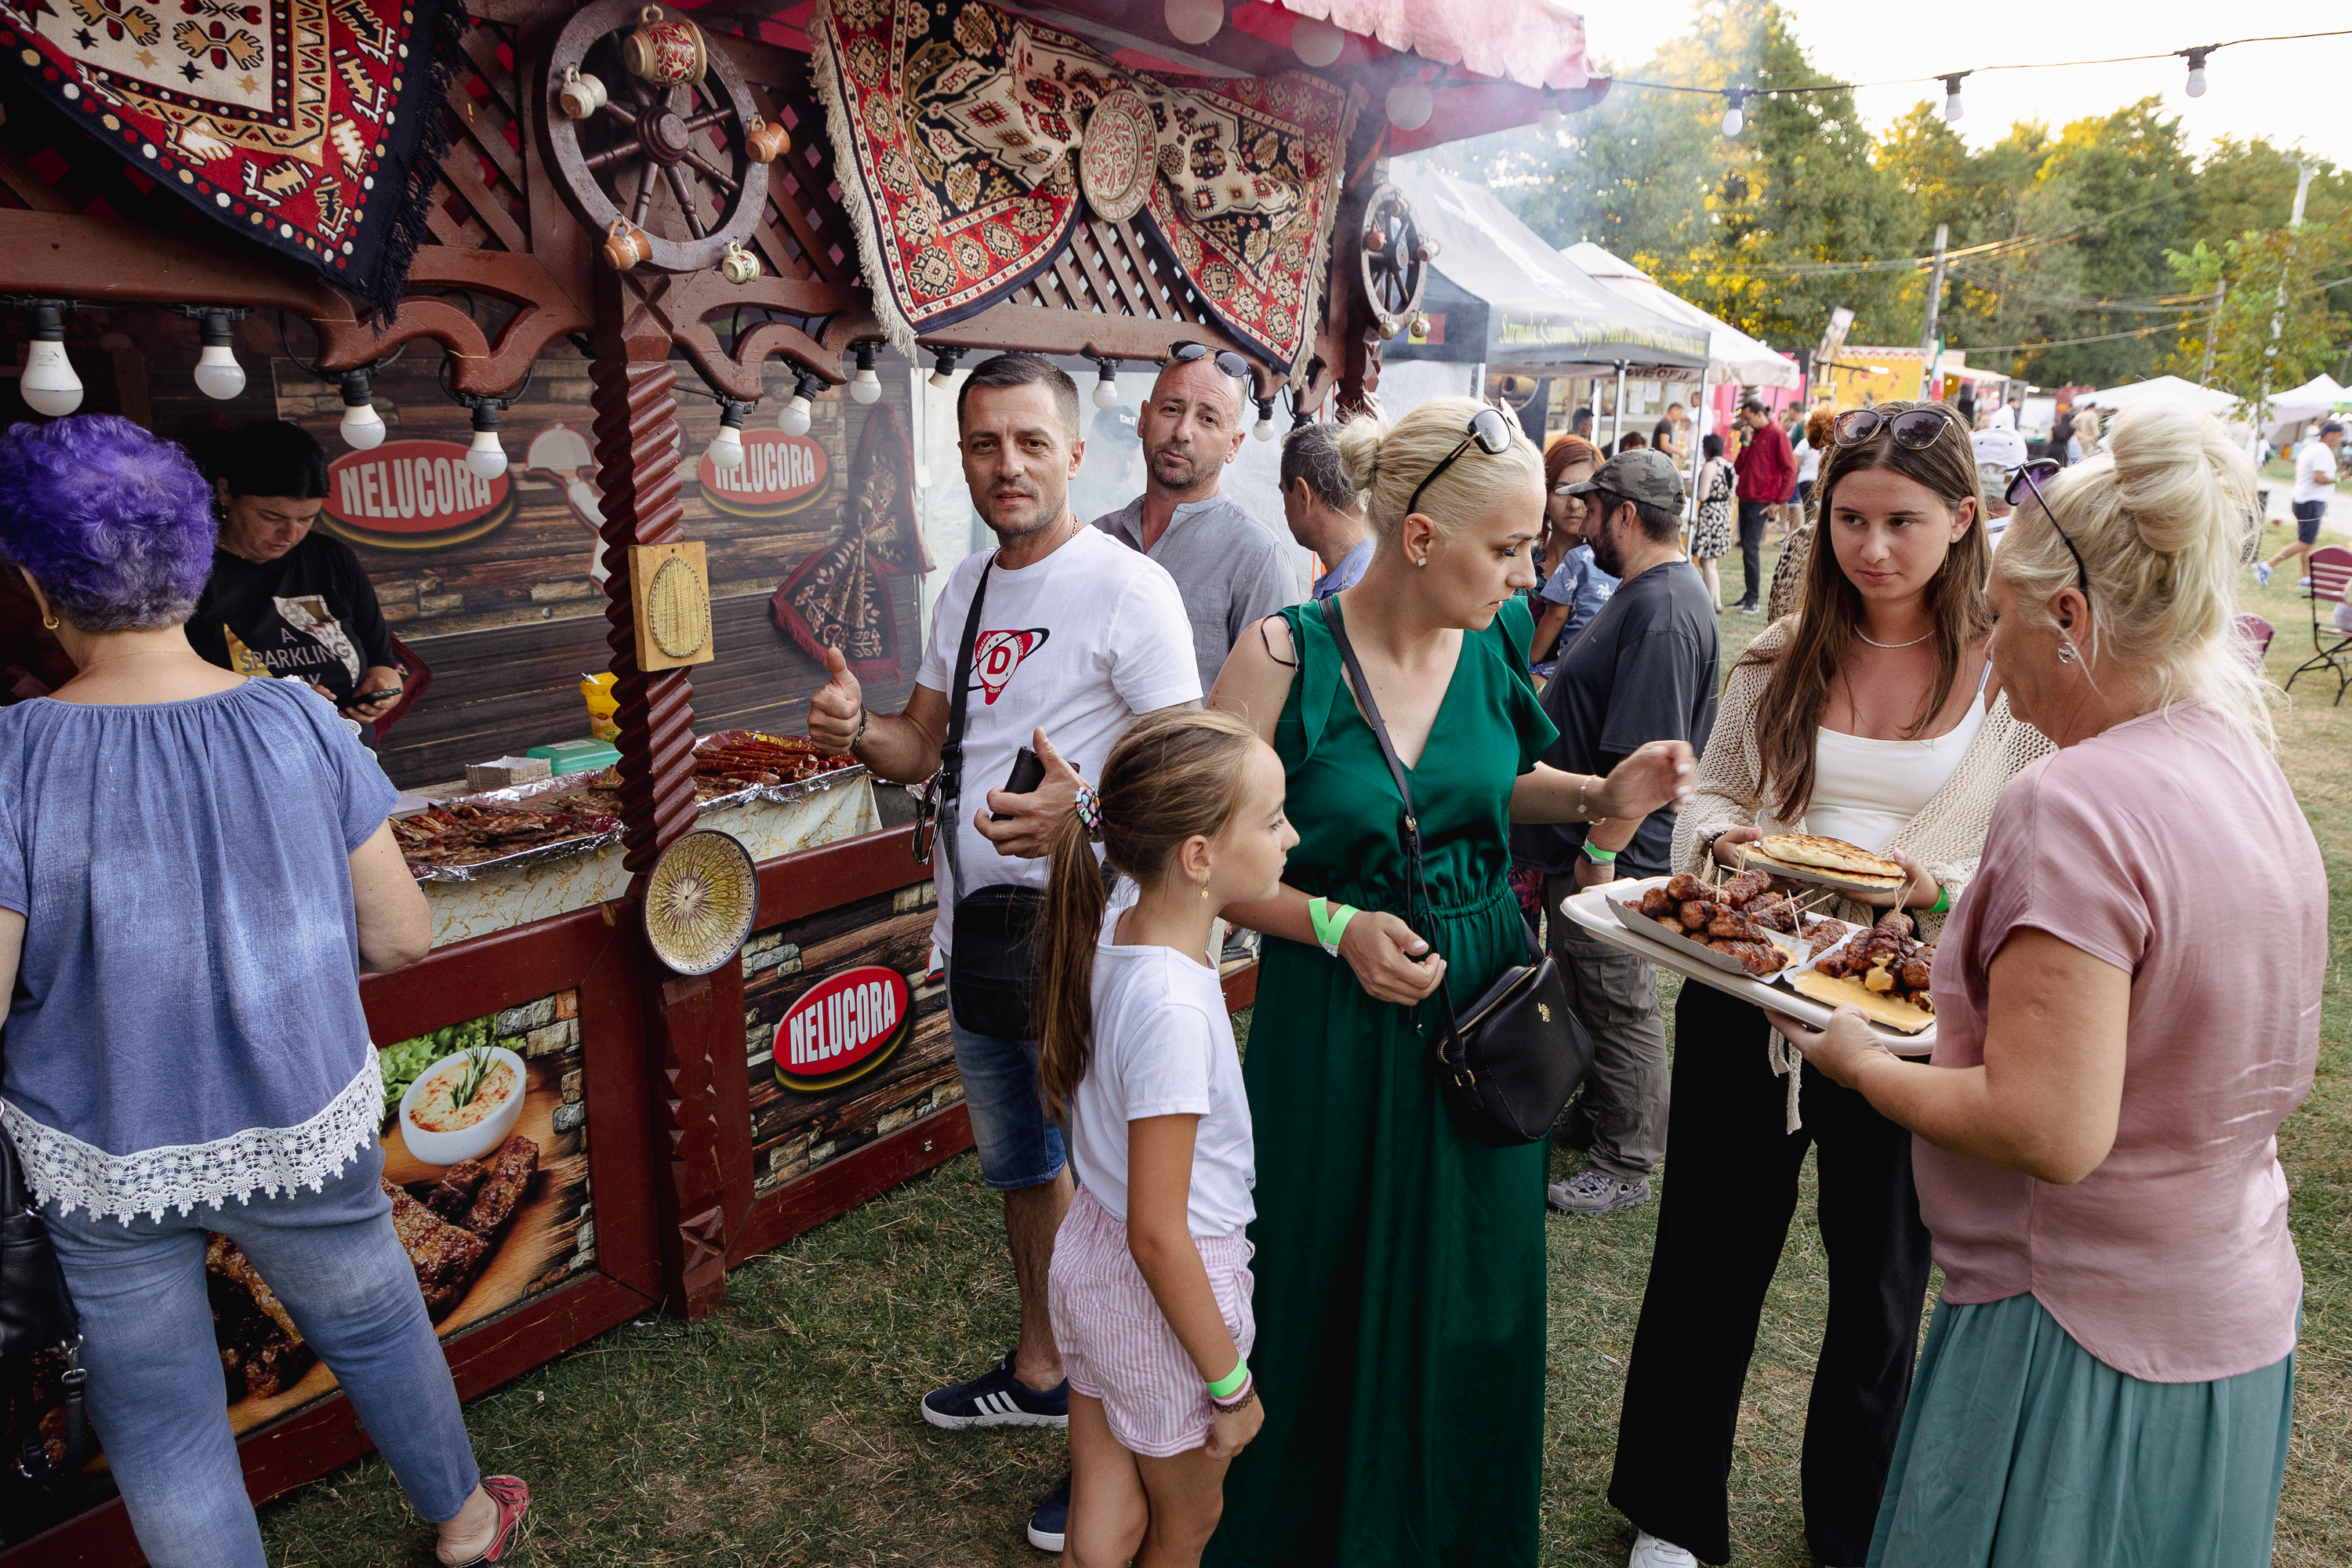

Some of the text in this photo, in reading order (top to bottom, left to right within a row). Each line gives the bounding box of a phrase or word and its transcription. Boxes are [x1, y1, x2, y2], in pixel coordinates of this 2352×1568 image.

[715, 442, 815, 493] NELUCORA
[339, 456, 492, 519] NELUCORA
[281, 628, 299, 643] A
[976, 633, 992, 659] OBSERVE
[239, 641, 350, 673] SPARKLING
[986, 646, 1011, 674] D
[789, 979, 896, 1065] NELUCORA
